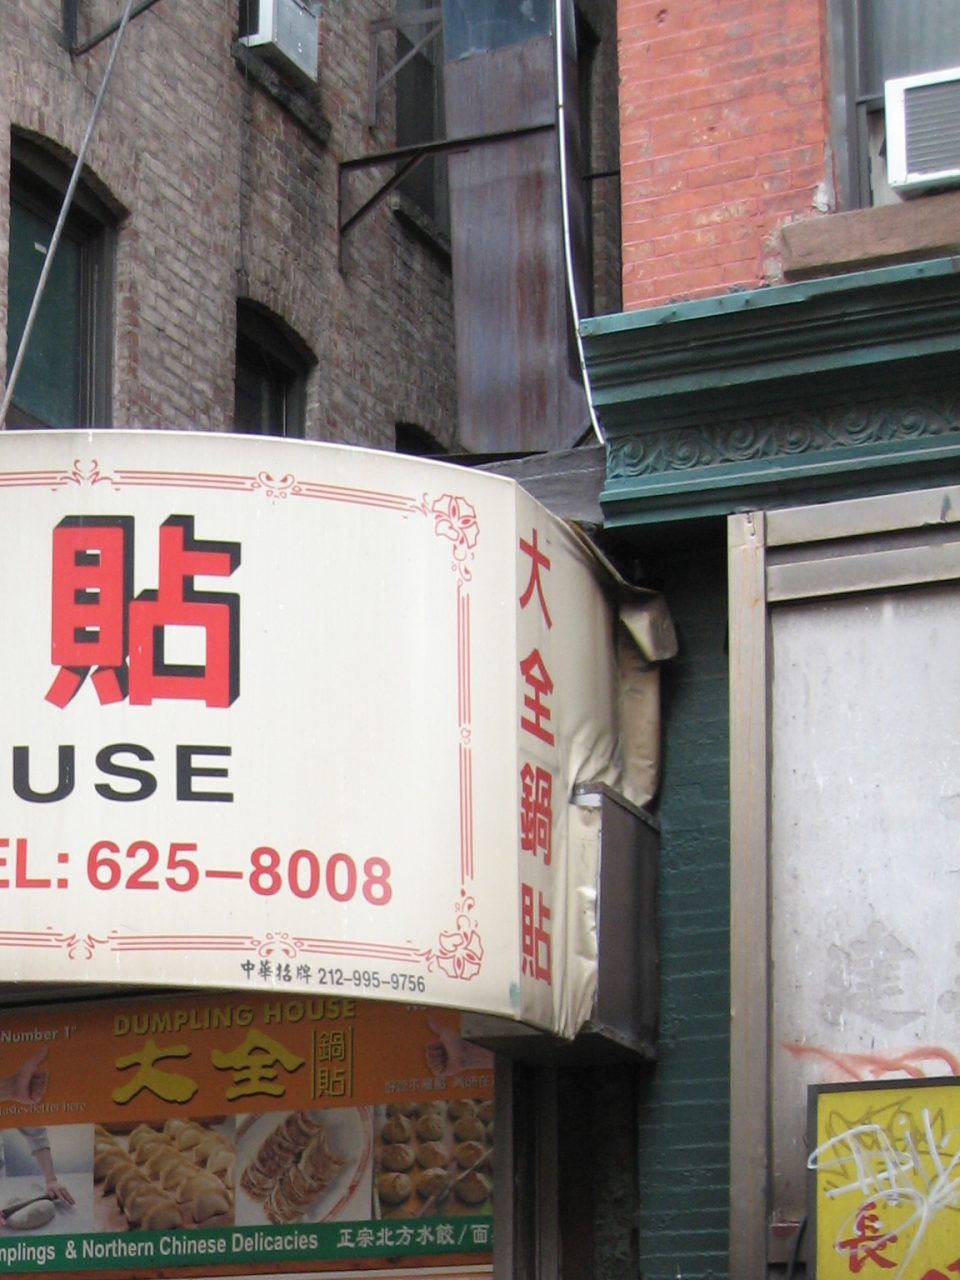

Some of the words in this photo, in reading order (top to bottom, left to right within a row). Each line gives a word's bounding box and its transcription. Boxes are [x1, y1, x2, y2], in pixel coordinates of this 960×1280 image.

[519, 527, 556, 988] 大全鍋貼
[318, 967, 426, 993] 212-995-9756
[113, 1005, 255, 1037] DUMPLING
[263, 1000, 357, 1025] HOUSE
[111, 1029, 306, 1105] 大全
[318, 1029, 346, 1099] 鍋貼
[65, 1240, 77, 1259] &
[82, 1237, 154, 1259] Northern
[159, 1235, 227, 1255] Chinese
[231, 1230, 319, 1253] Delicacies
